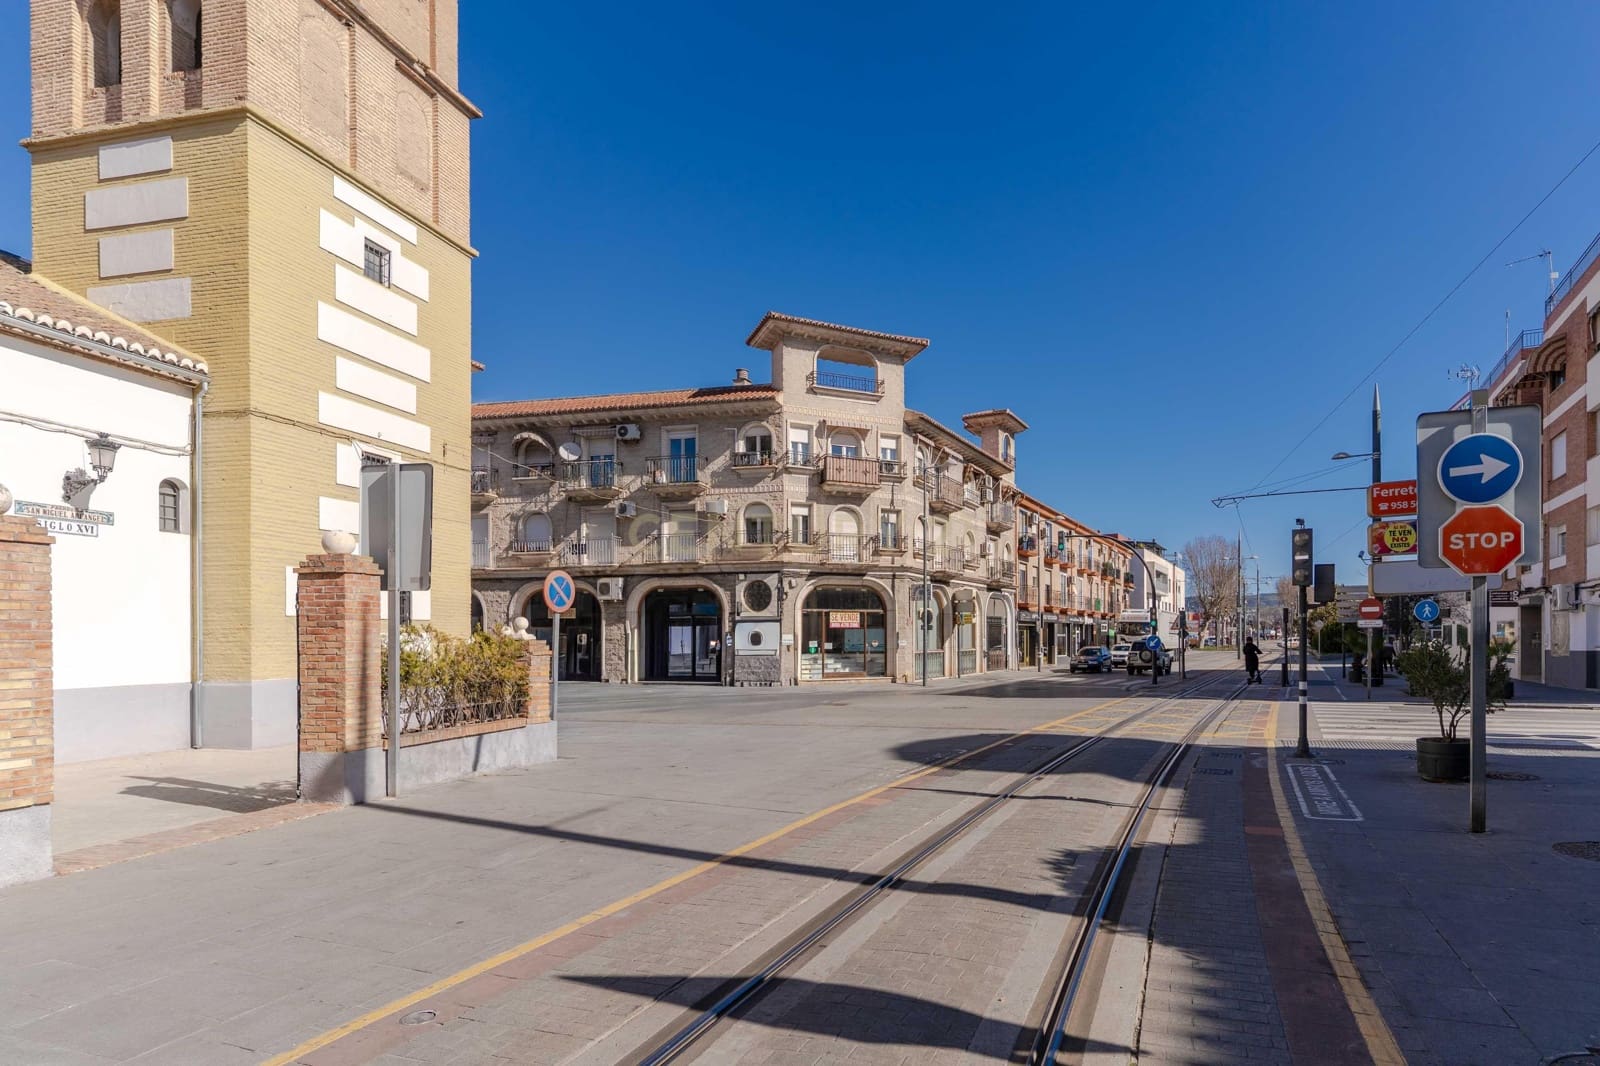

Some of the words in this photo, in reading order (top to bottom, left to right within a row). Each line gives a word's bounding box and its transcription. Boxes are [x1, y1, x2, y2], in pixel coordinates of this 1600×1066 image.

[1391, 501, 1408, 510] 958
[1410, 500, 1418, 508] 5
[25, 506, 40, 515] SAN
[43, 508, 68, 519] MIGUEL
[36, 519, 73, 532] SIGLO
[77, 524, 95, 534] XVI
[1398, 529, 1412, 537] VEN
[1449, 532, 1515, 549] STOP
[831, 613, 839, 622] SE
[840, 613, 859, 622] VENDE
